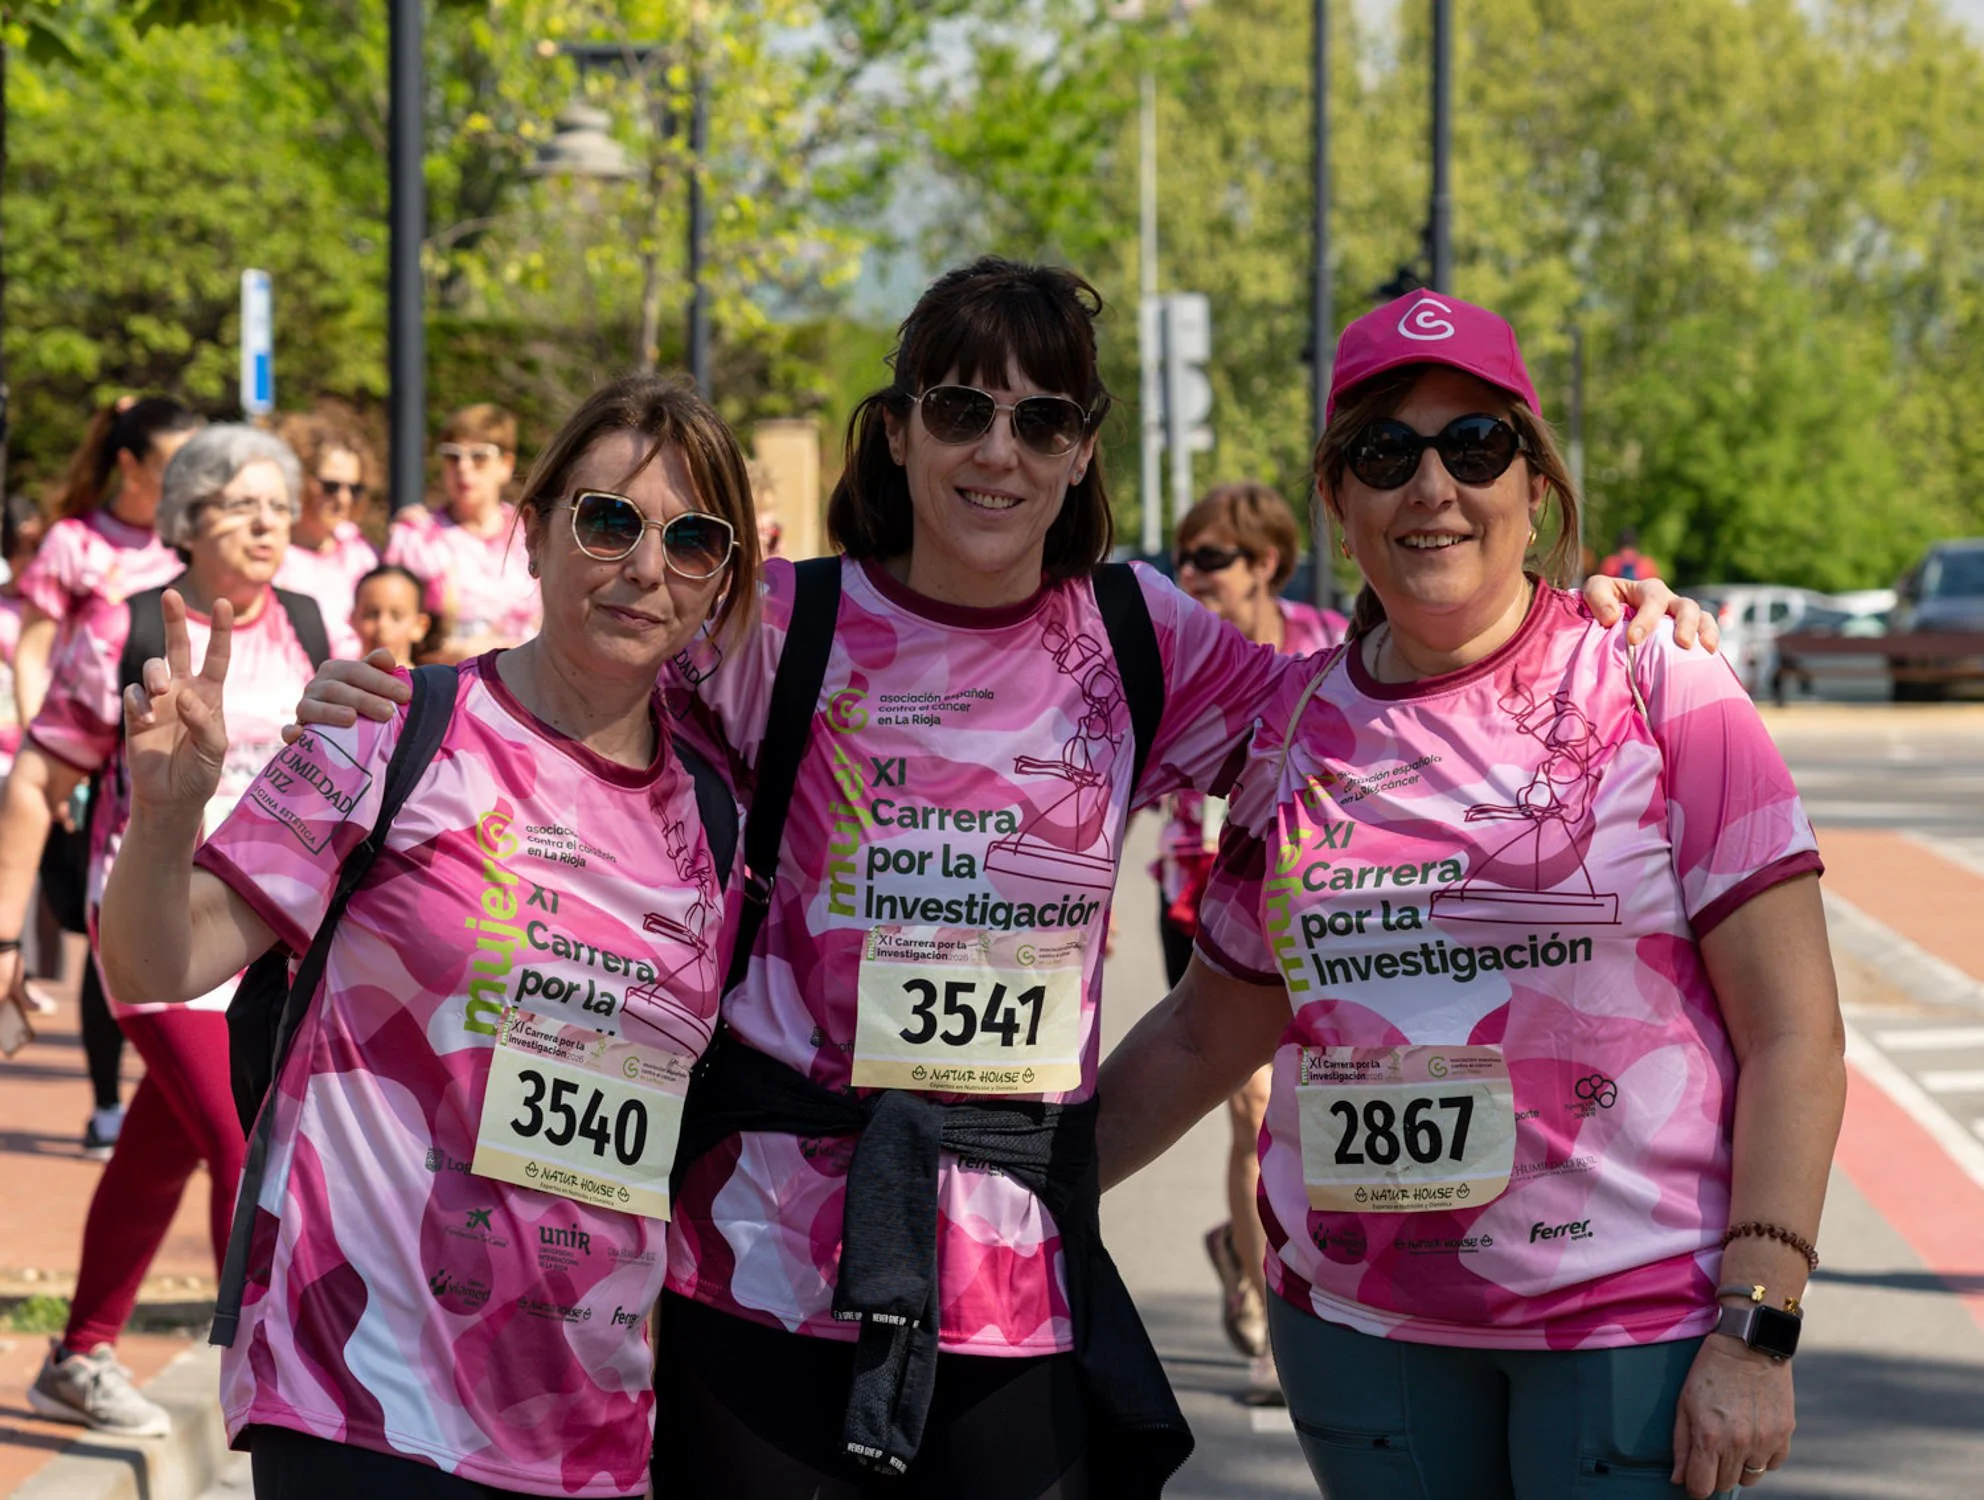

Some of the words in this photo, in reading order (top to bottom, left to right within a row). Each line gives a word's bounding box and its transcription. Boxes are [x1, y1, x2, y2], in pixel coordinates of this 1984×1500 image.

[878, 705, 916, 713] contra
[880, 692, 941, 703] asociación
[944, 688, 995, 701] española
[877, 716, 892, 725] en
[895, 715, 909, 725] La
[912, 714, 941, 727] Rioja
[280, 748, 354, 815] UMILDAD
[870, 757, 907, 787] XI
[828, 744, 874, 917] mujer
[870, 798, 1018, 834] Carrera
[527, 835, 564, 850] contra
[566, 840, 578, 850] el
[1312, 821, 1355, 851] XI
[527, 846, 542, 857] en
[544, 848, 557, 861] La
[559, 852, 587, 868] Rioja
[867, 845, 933, 881] por
[942, 844, 976, 878] la
[1302, 859, 1464, 893] Carrera
[526, 881, 559, 914] XI
[864, 884, 1100, 932] Investigación
[1301, 908, 1372, 949] por
[1381, 900, 1422, 932] la
[464, 858, 529, 1035] mujer
[527, 920, 656, 985] Carrera
[877, 948, 948, 961] investigación
[879, 934, 892, 946] XI
[895, 937, 936, 948] Carrera
[937, 941, 954, 951] por
[957, 940, 967, 950] la
[1311, 933, 1593, 986] Investigación
[514, 968, 581, 1003] por
[582, 979, 617, 1017] la
[899, 978, 1046, 1047] 3541
[508, 1034, 567, 1058] investigación
[511, 1019, 525, 1033] XI
[525, 1027, 558, 1043] Carrera
[559, 1038, 576, 1050] por
[576, 1039, 585, 1051] la
[930, 1068, 977, 1081] NATUR
[979, 1071, 1020, 1083] HOUSE
[1309, 1056, 1321, 1069] XI
[1323, 1060, 1355, 1069] Carrera
[1356, 1061, 1370, 1070] por
[1310, 1071, 1366, 1083] investigación
[510, 1070, 648, 1166] 3540
[1330, 1095, 1474, 1165] 2867
[540, 1167, 579, 1187] NATUR
[580, 1178, 615, 1198] HOUSE
[1370, 1188, 1411, 1201] NATUR
[1413, 1187, 1454, 1200] HOUSE
